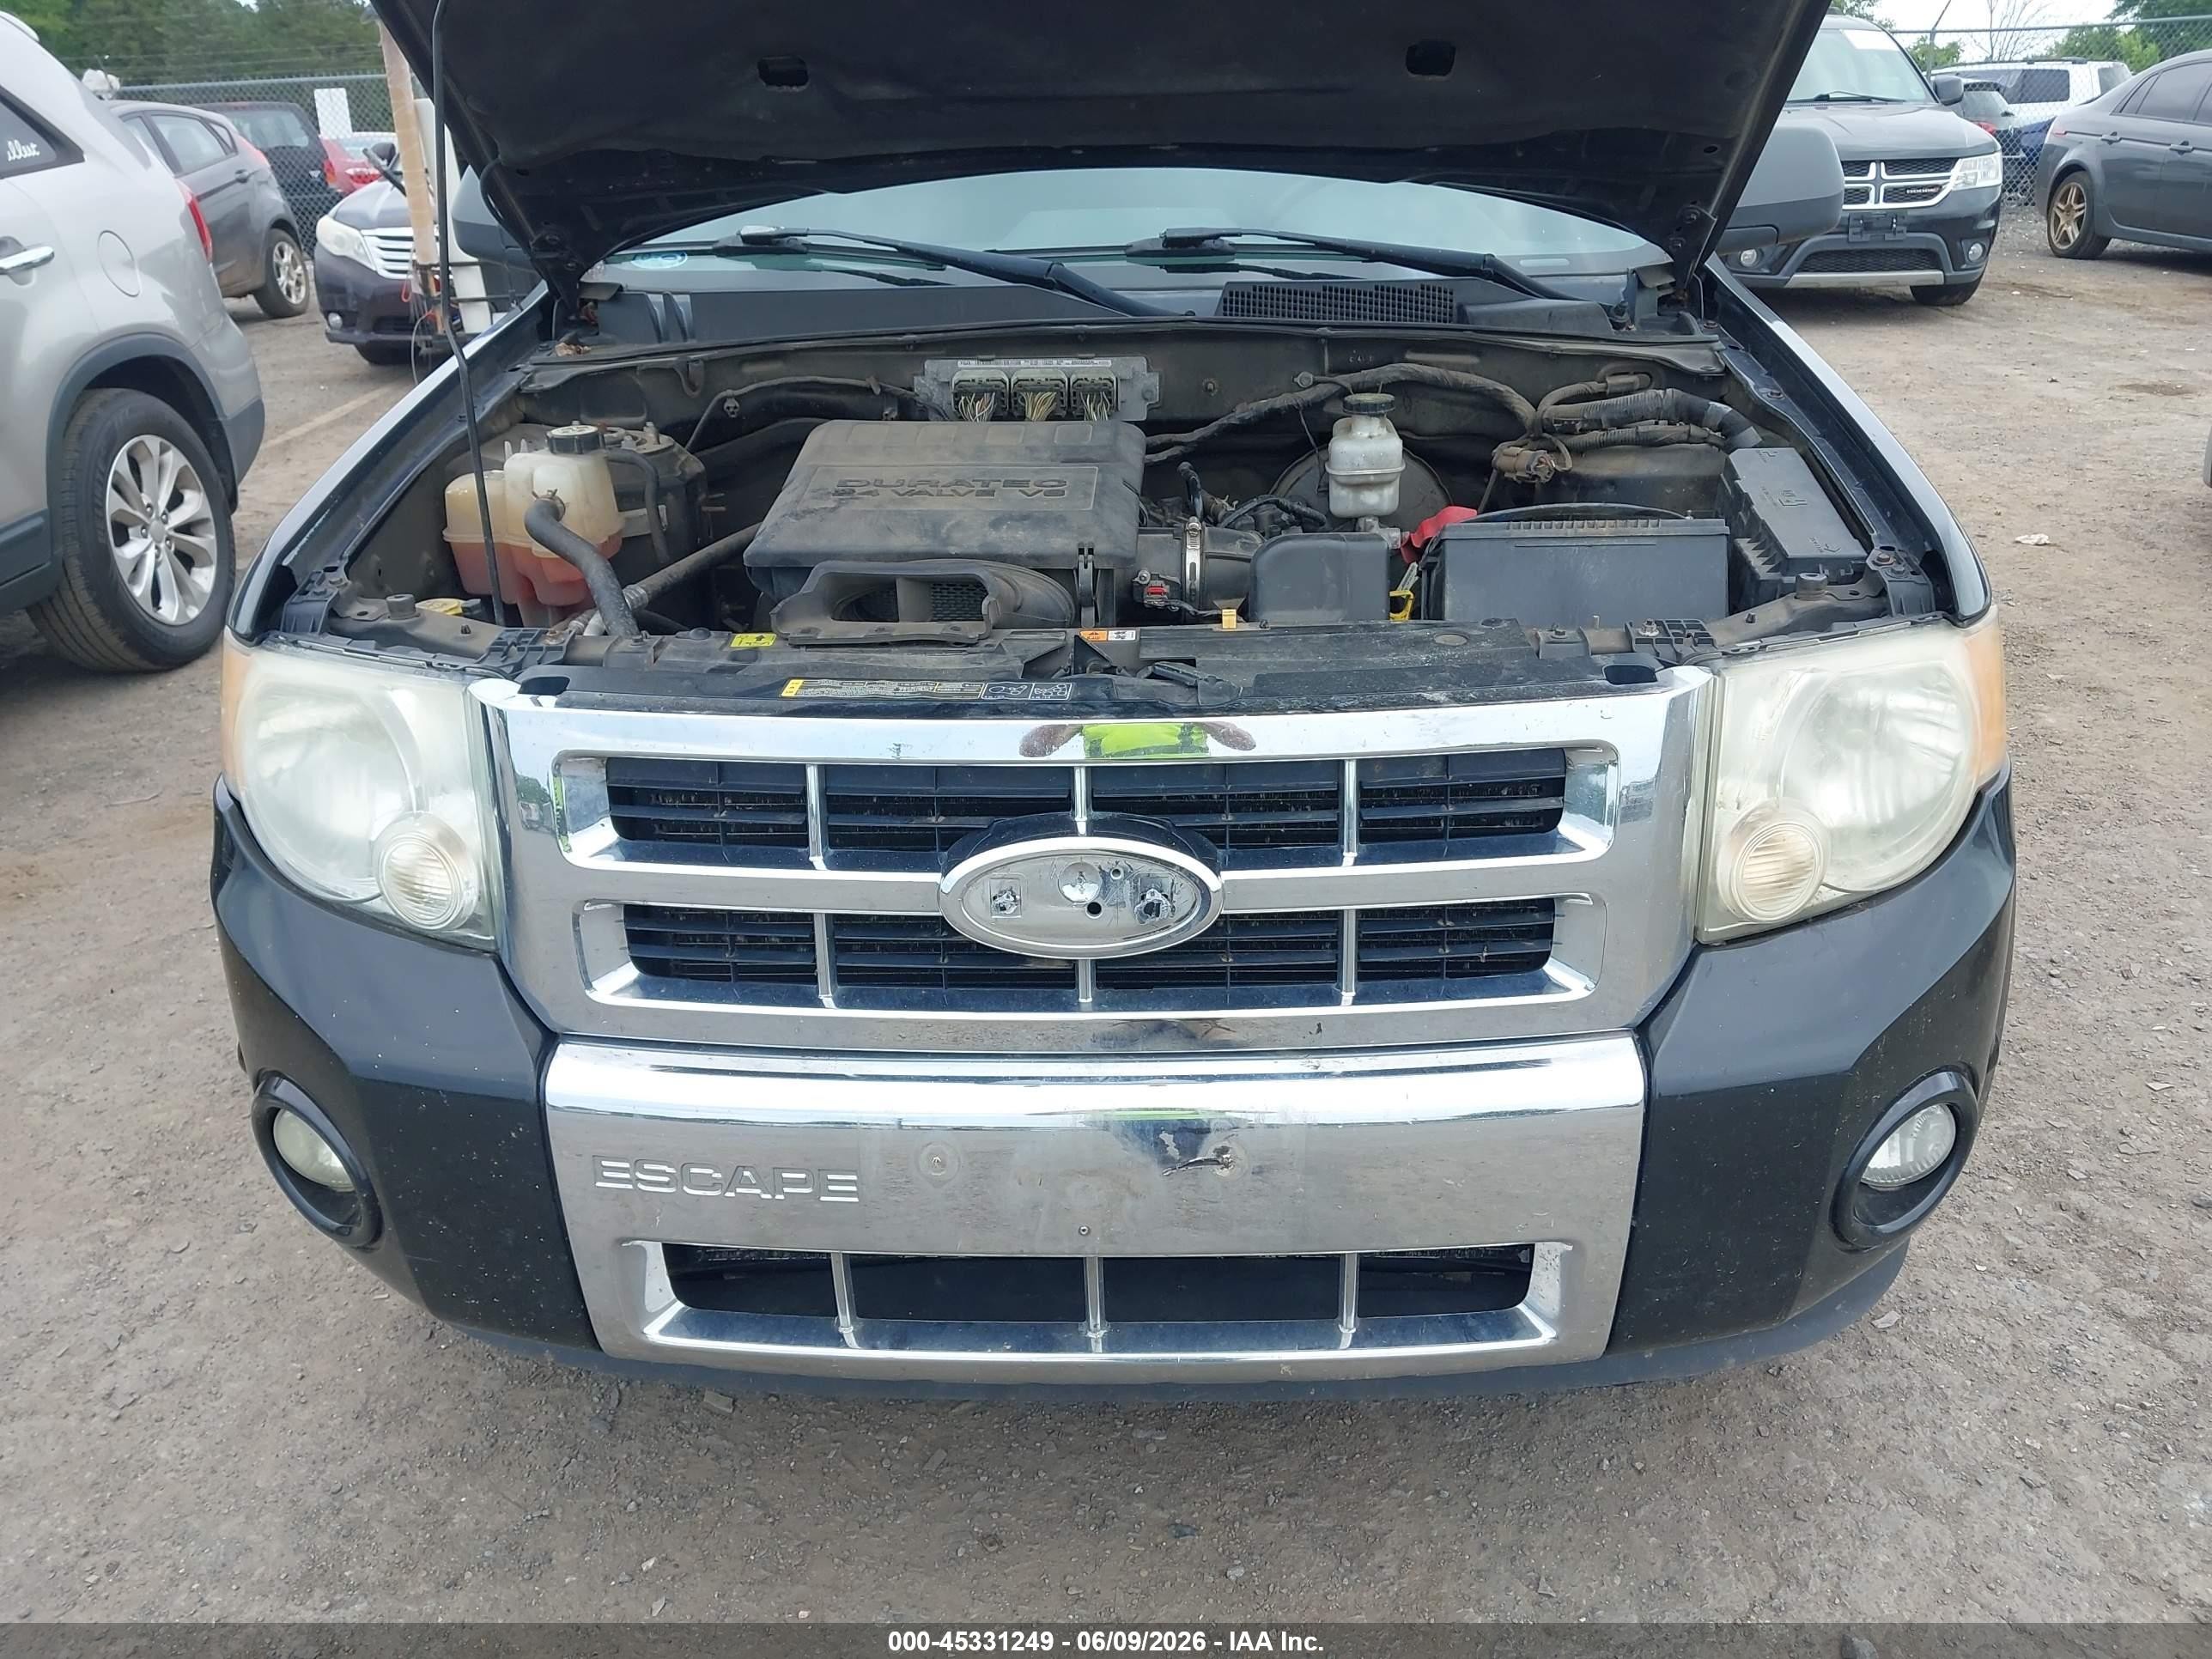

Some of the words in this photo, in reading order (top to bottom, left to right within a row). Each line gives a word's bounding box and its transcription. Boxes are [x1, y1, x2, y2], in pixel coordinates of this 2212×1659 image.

[836, 478, 1067, 489] DURATEC
[890, 489, 996, 497] VALVE
[592, 1155, 860, 1202] ESCAPE
